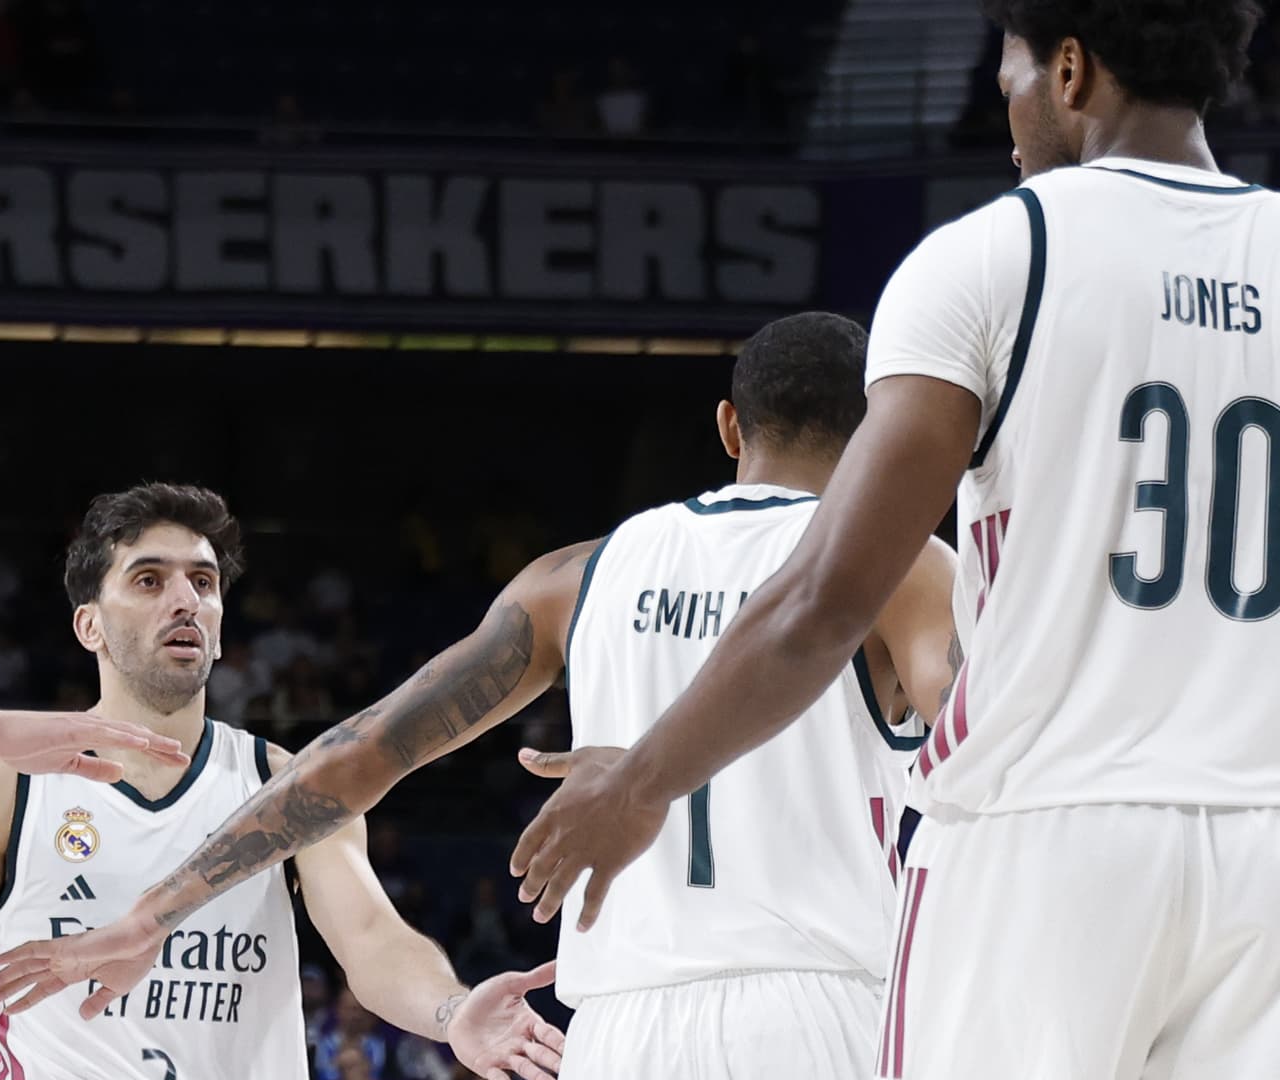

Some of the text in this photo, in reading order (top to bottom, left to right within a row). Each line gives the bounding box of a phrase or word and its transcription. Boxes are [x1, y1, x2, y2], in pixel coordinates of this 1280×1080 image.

[1160, 270, 1263, 335] JONES
[49, 917, 268, 973] rates
[145, 979, 242, 1023] BETTER
